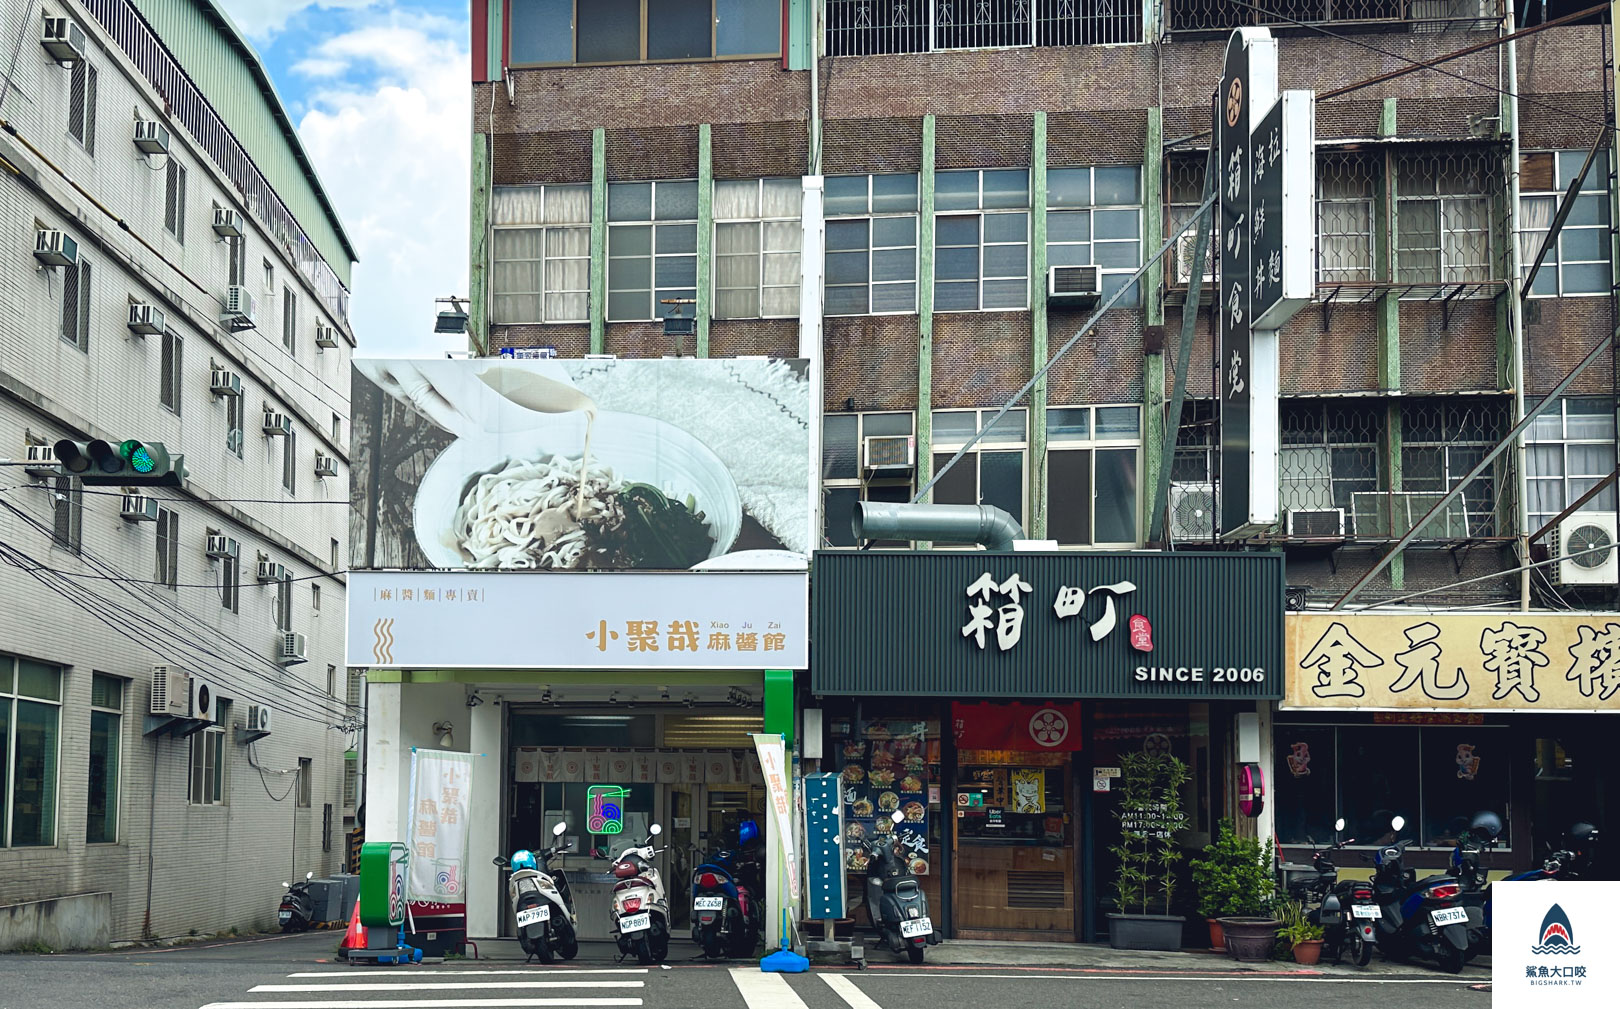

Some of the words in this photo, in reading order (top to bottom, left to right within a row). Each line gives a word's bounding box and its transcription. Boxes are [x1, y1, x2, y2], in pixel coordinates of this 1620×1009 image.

[710, 621, 730, 629] Xiao
[741, 621, 753, 629] Ju
[767, 621, 781, 629] Zai
[962, 572, 1137, 651] 箱町
[585, 619, 700, 652] 小聚哉
[706, 631, 786, 652] 麻醬館
[1131, 617, 1151, 647] 食堂
[1134, 666, 1204, 682] SINCE
[1212, 667, 1265, 682] 2006
